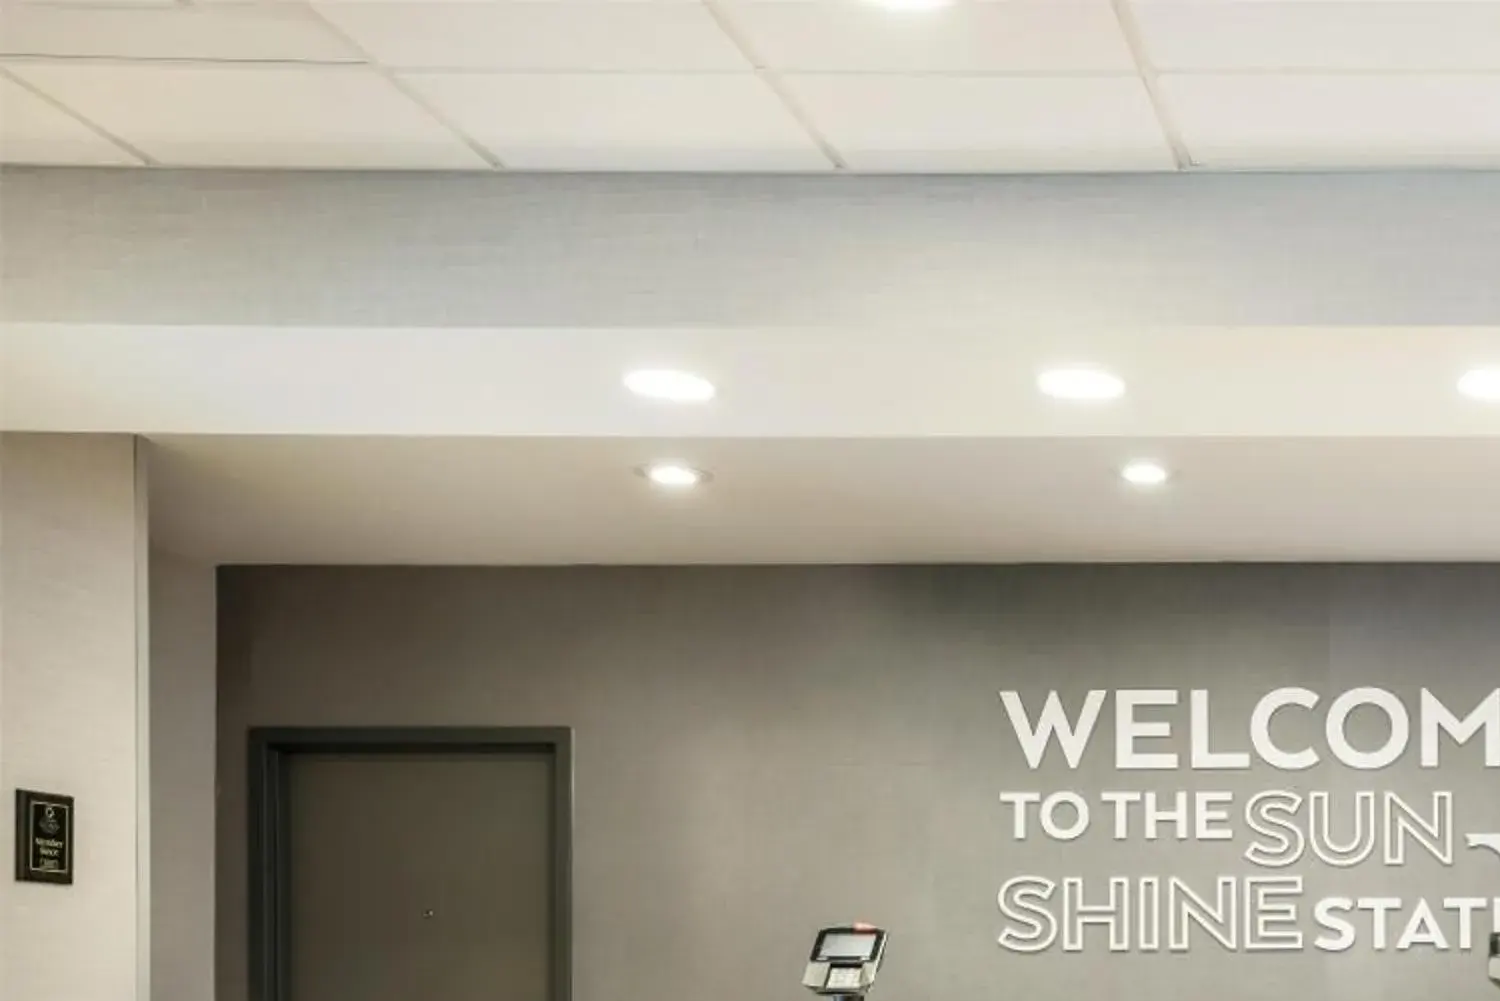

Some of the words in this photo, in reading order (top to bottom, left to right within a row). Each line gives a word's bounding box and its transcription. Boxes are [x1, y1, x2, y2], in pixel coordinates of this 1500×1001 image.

[1000, 791, 1089, 840] TO
[1101, 791, 1233, 840] THE
[1244, 791, 1453, 866] SUN
[997, 877, 1304, 952] SHINE
